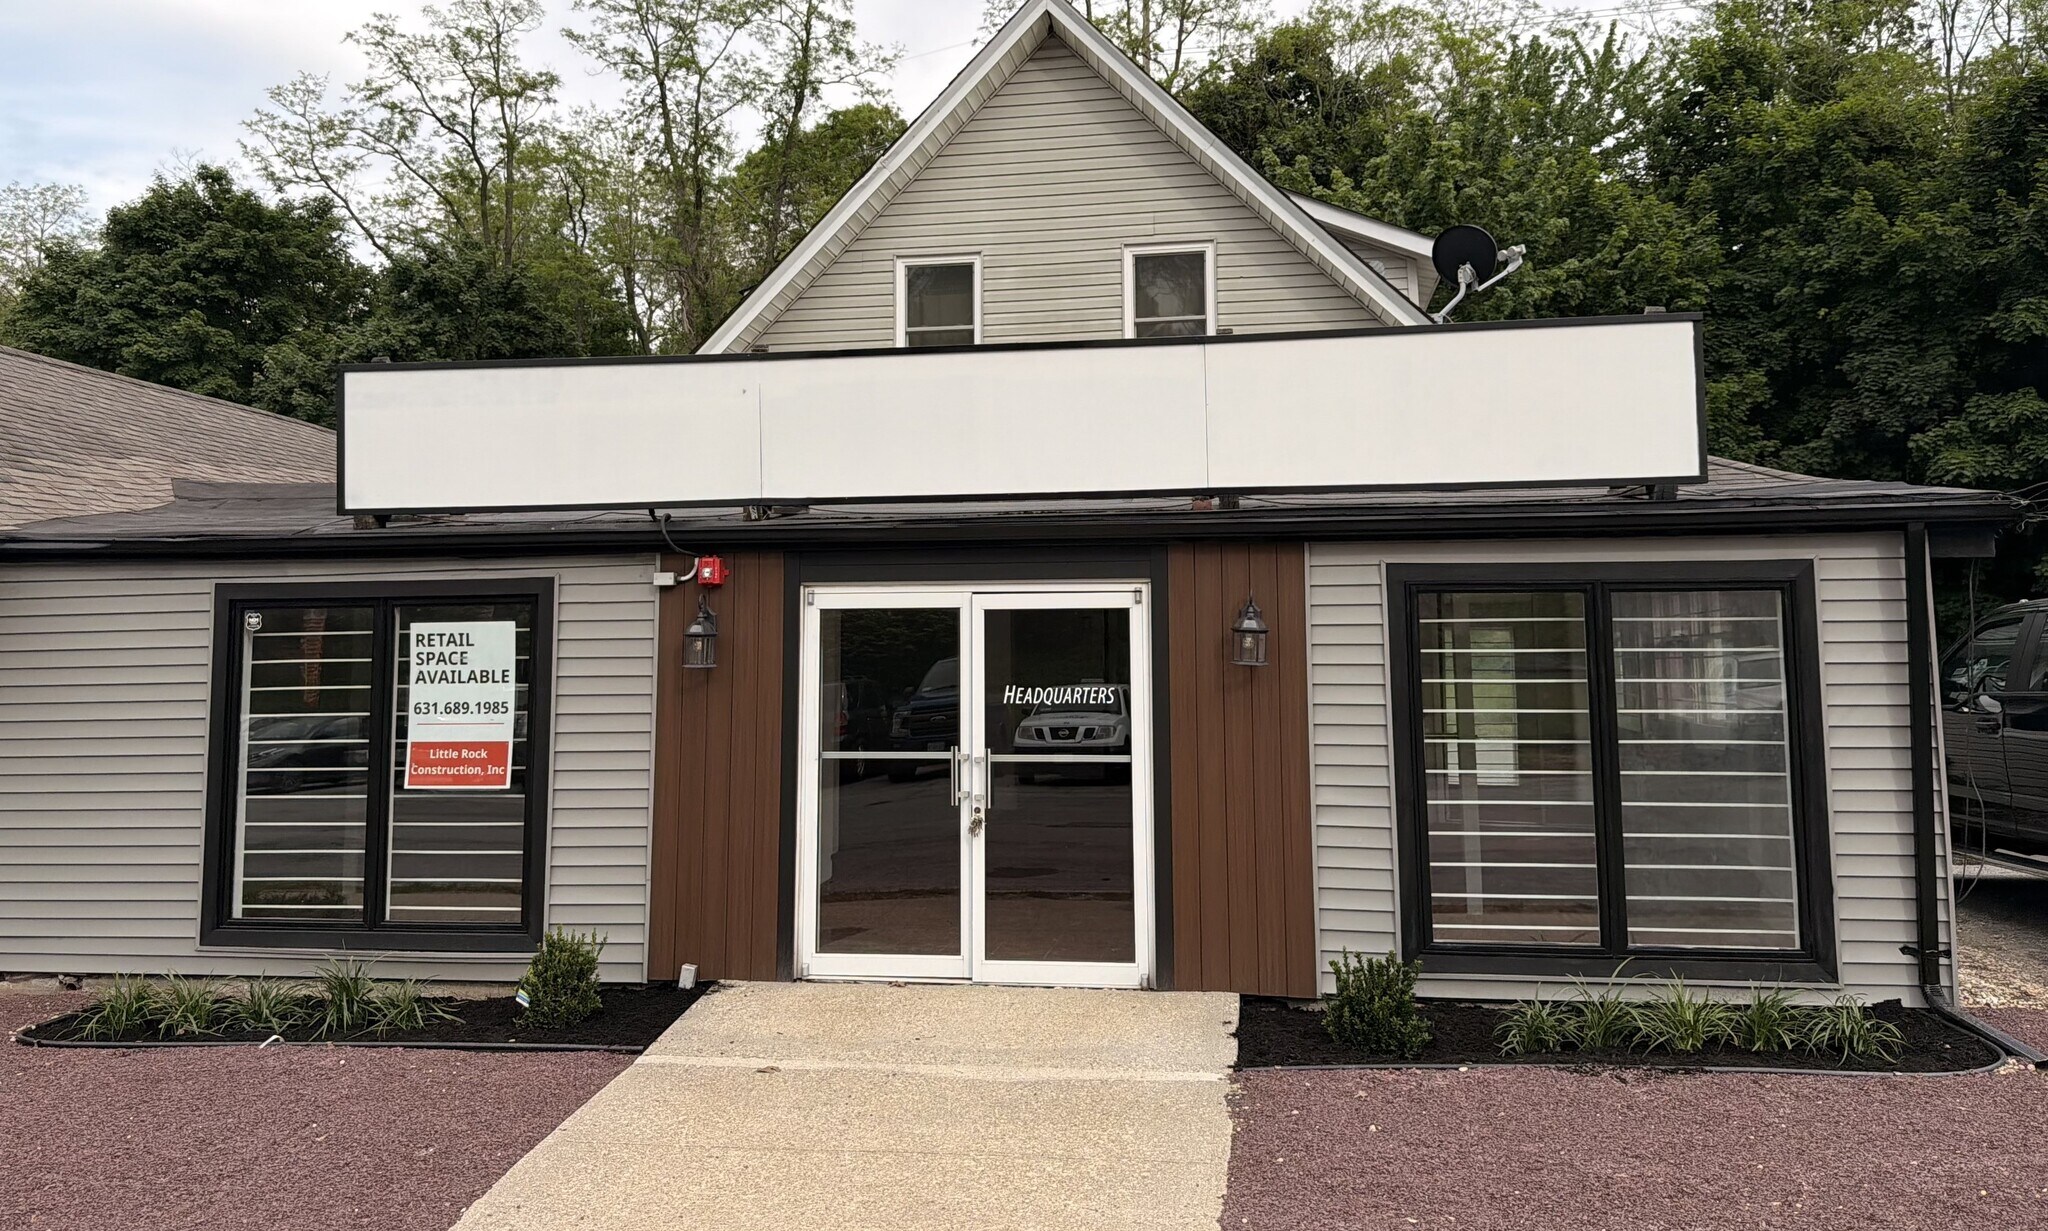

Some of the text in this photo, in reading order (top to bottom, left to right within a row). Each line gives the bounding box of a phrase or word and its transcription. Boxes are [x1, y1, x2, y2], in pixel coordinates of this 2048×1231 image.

[415, 633, 475, 647] RETAIL
[415, 651, 468, 666] SPACE
[415, 669, 510, 684] AVAILABLE
[413, 701, 509, 715] 631.689.1985
[429, 748, 488, 759] Little Rock
[411, 764, 505, 776] Construction, Inc
